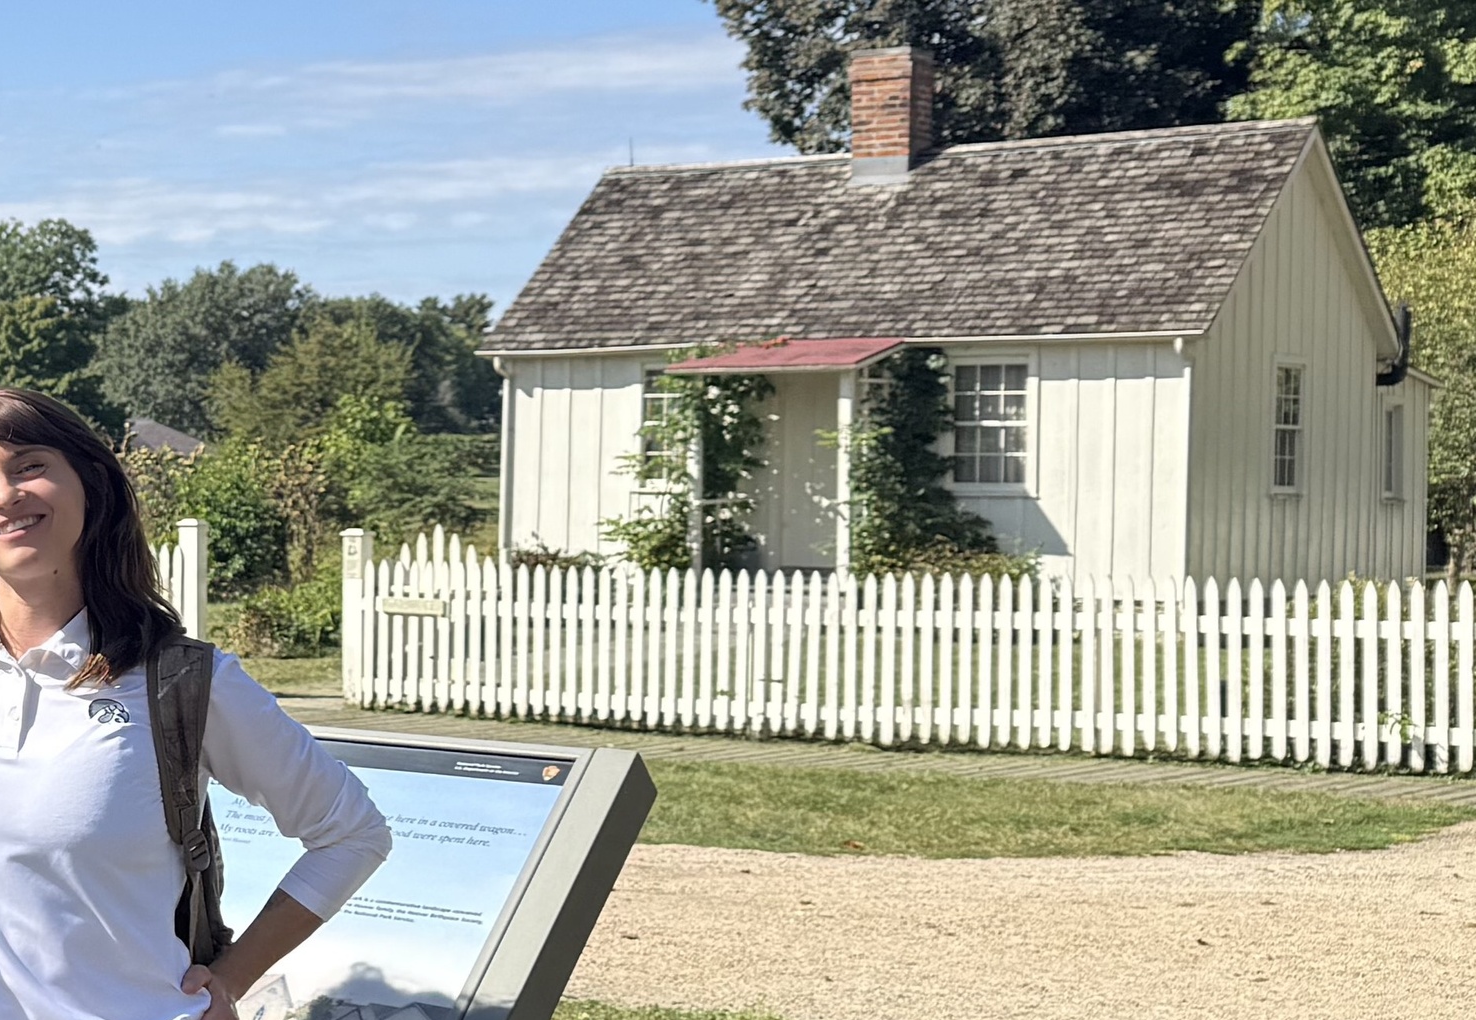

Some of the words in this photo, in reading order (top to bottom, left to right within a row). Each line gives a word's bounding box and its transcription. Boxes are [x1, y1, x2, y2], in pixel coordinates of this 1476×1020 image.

[225, 810, 242, 819] The
[244, 814, 266, 822] most
[412, 832, 437, 841] were
[438, 835, 466, 844] spent
[466, 836, 491, 847] here.
[234, 827, 257, 835] roots
[395, 814, 417, 824] here
[417, 816, 429, 825] in
[438, 820, 480, 831] covered
